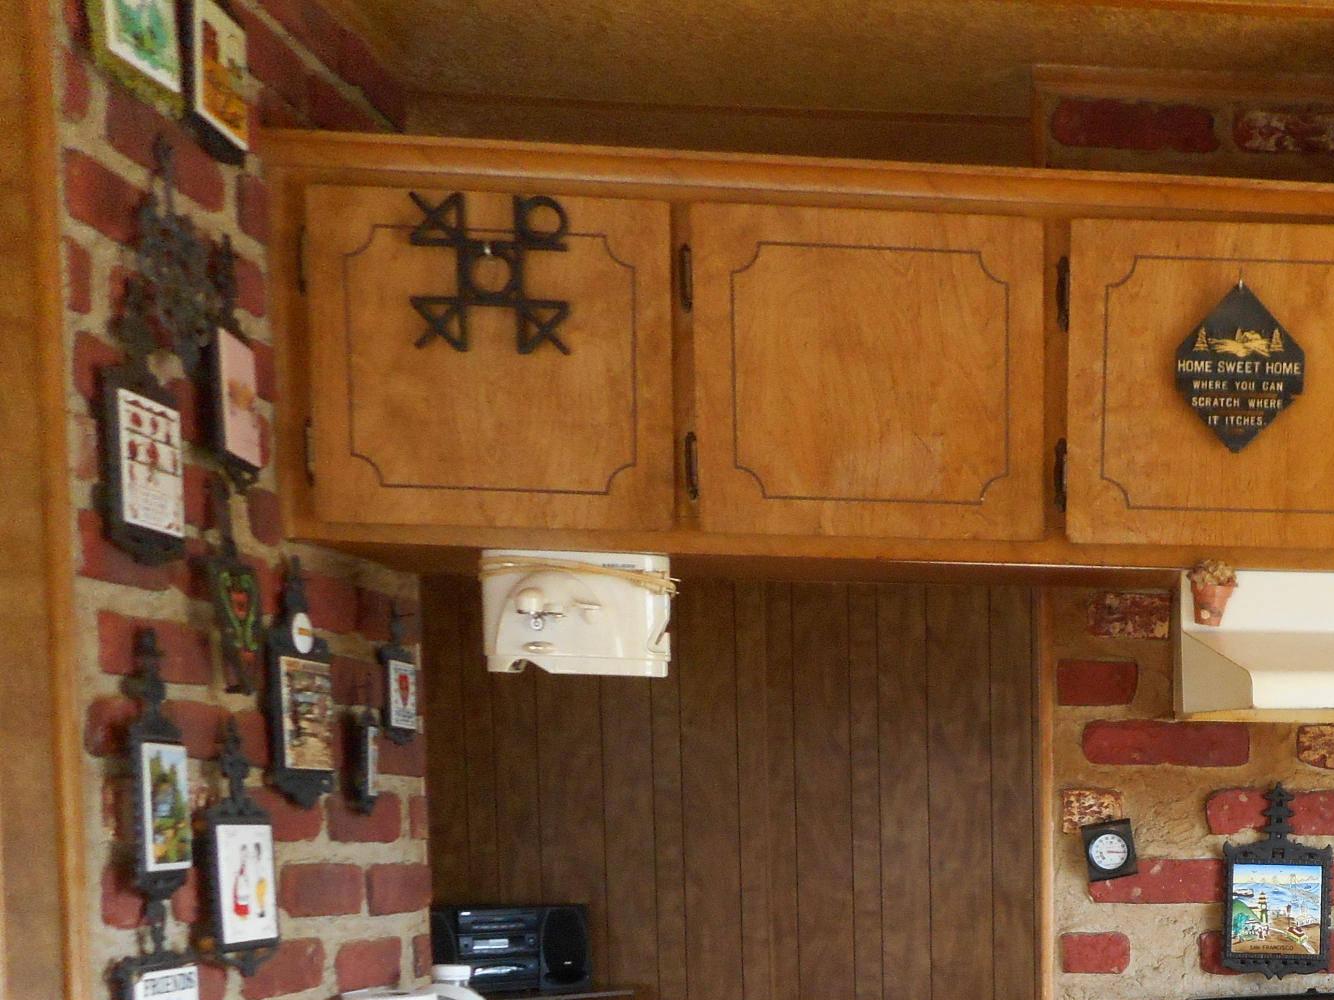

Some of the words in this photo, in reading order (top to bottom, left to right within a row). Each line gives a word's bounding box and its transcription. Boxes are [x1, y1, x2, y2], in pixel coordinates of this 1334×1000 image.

[1177, 359, 1213, 373] HOME
[1217, 361, 1261, 374] SWEET
[1265, 362, 1302, 375] HOME
[1192, 380, 1228, 390] WHERE
[1235, 380, 1255, 391] YOU
[1262, 381, 1284, 392] CAN
[1191, 396, 1240, 408] SCRATCH
[1248, 398, 1283, 409] WHERE
[1208, 415, 1219, 426] IT
[1225, 415, 1267, 427] ITCHES.
[1262, 944, 1295, 952] FRANCISCO
